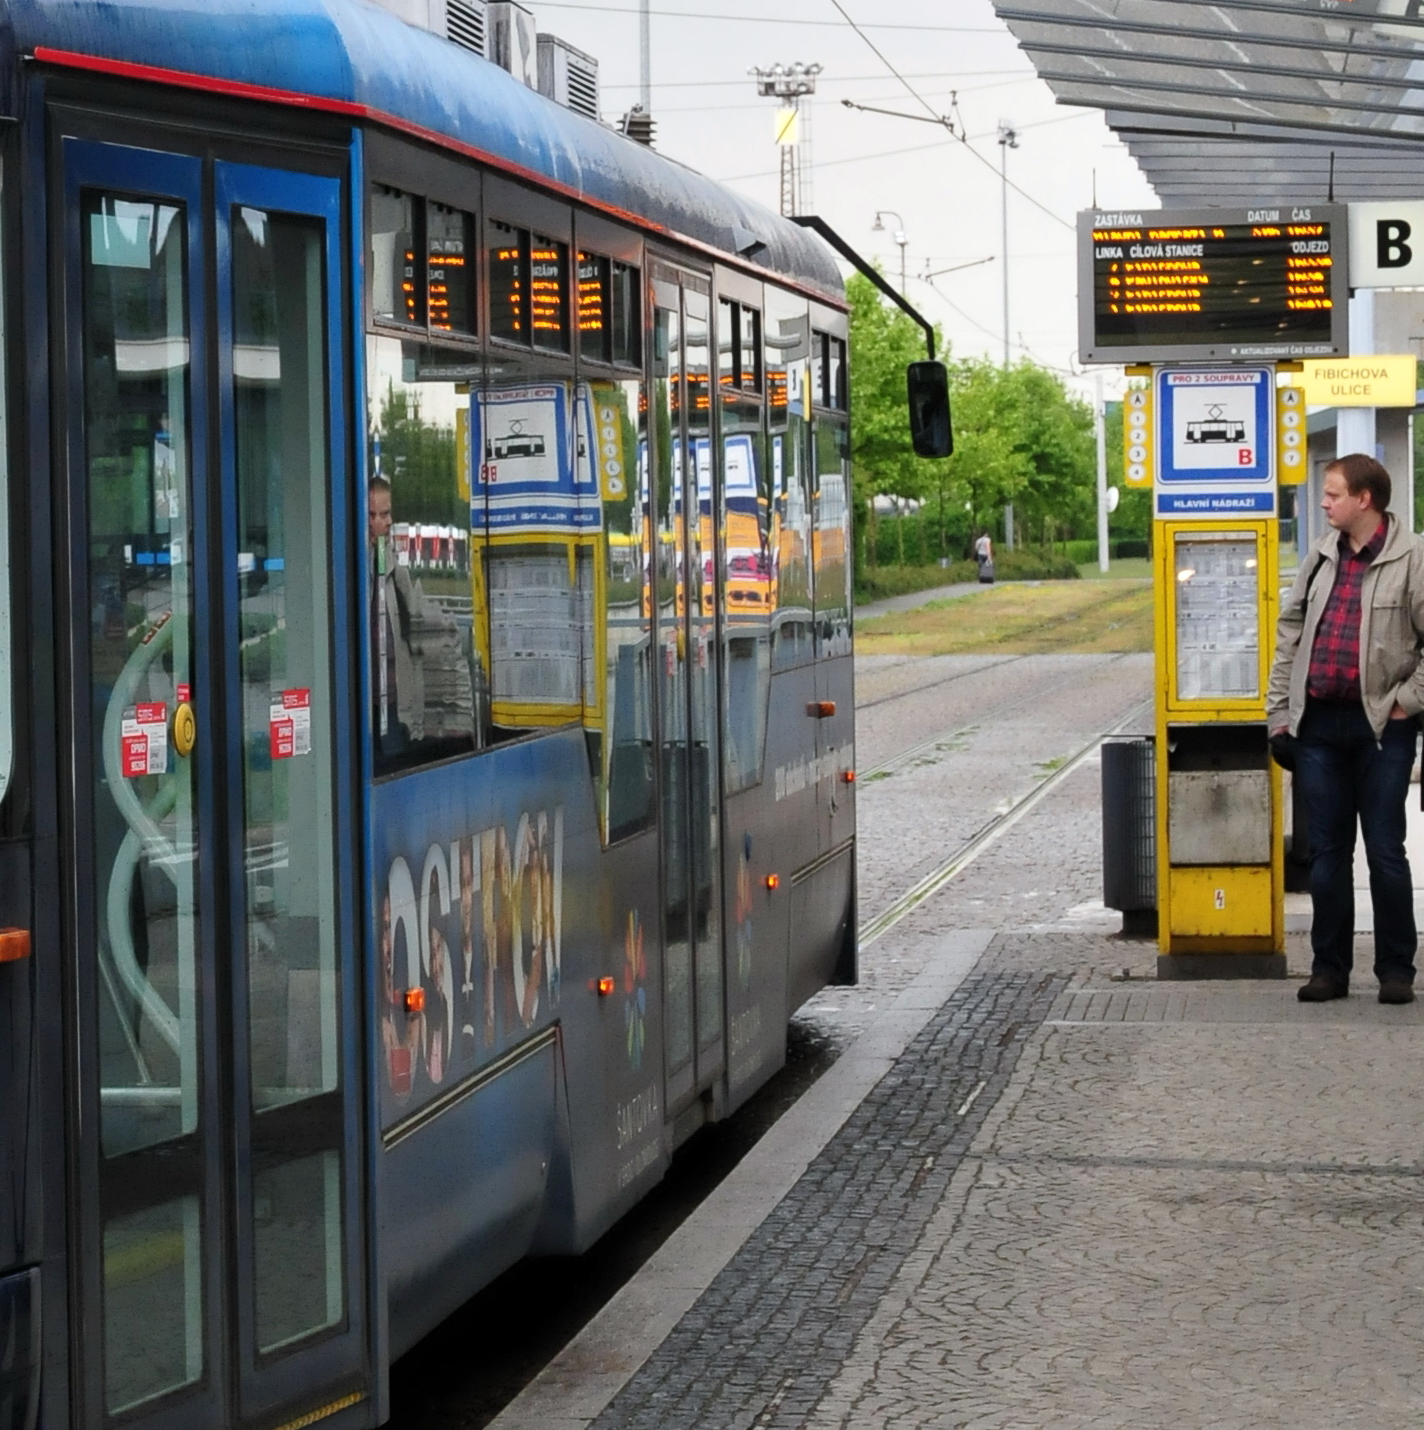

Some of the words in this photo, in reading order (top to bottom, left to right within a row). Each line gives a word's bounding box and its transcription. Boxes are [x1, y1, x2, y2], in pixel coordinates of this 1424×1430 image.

[1094, 212, 1143, 226] ZASTÁVKA
[1247, 210, 1280, 222] DATUM
[1291, 207, 1311, 221] ČAS
[1096, 246, 1124, 259] LINKA
[1129, 243, 1164, 258] CÍLOVÁ
[1165, 244, 1204, 257] STANICE
[1292, 240, 1329, 253] ODJEZD
[1377, 219, 1412, 269] B
[1172, 375, 1193, 383] PRO
[1195, 375, 1201, 383] 2
[1204, 374, 1255, 383] SOUPRAVY
[1314, 368, 1389, 380] FIBICHOVA
[1331, 384, 1371, 396] ULICE
[1238, 448, 1253, 465] B
[1173, 497, 1210, 508] HLAVNÍ
[1211, 497, 1255, 508] NÁDRAŽÍ
